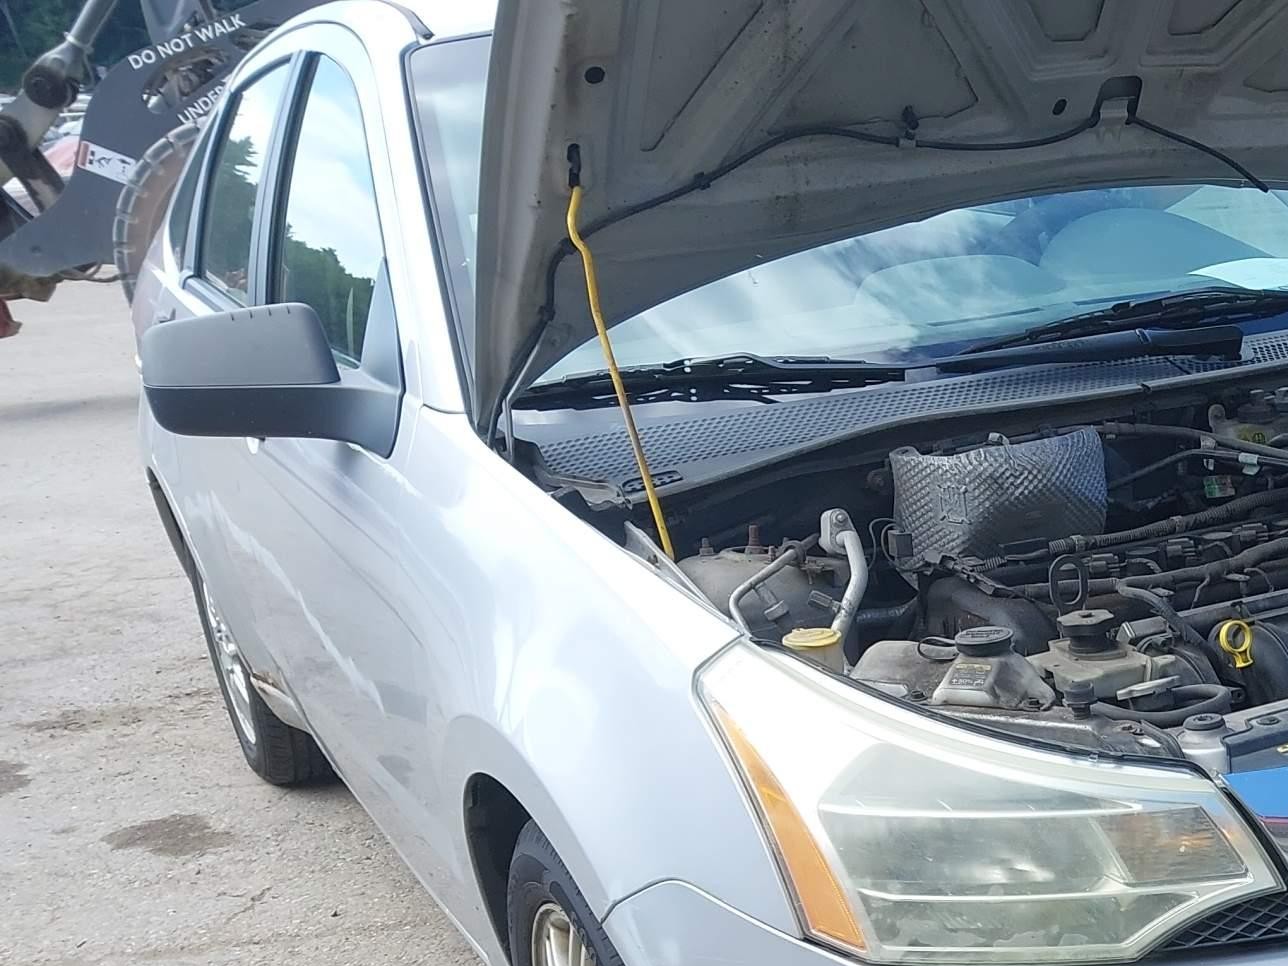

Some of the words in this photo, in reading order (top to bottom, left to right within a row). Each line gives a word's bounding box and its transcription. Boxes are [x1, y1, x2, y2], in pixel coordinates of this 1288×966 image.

[127, 49, 156, 70] DO
[156, 33, 194, 59] NOT
[194, 13, 246, 43] WALK
